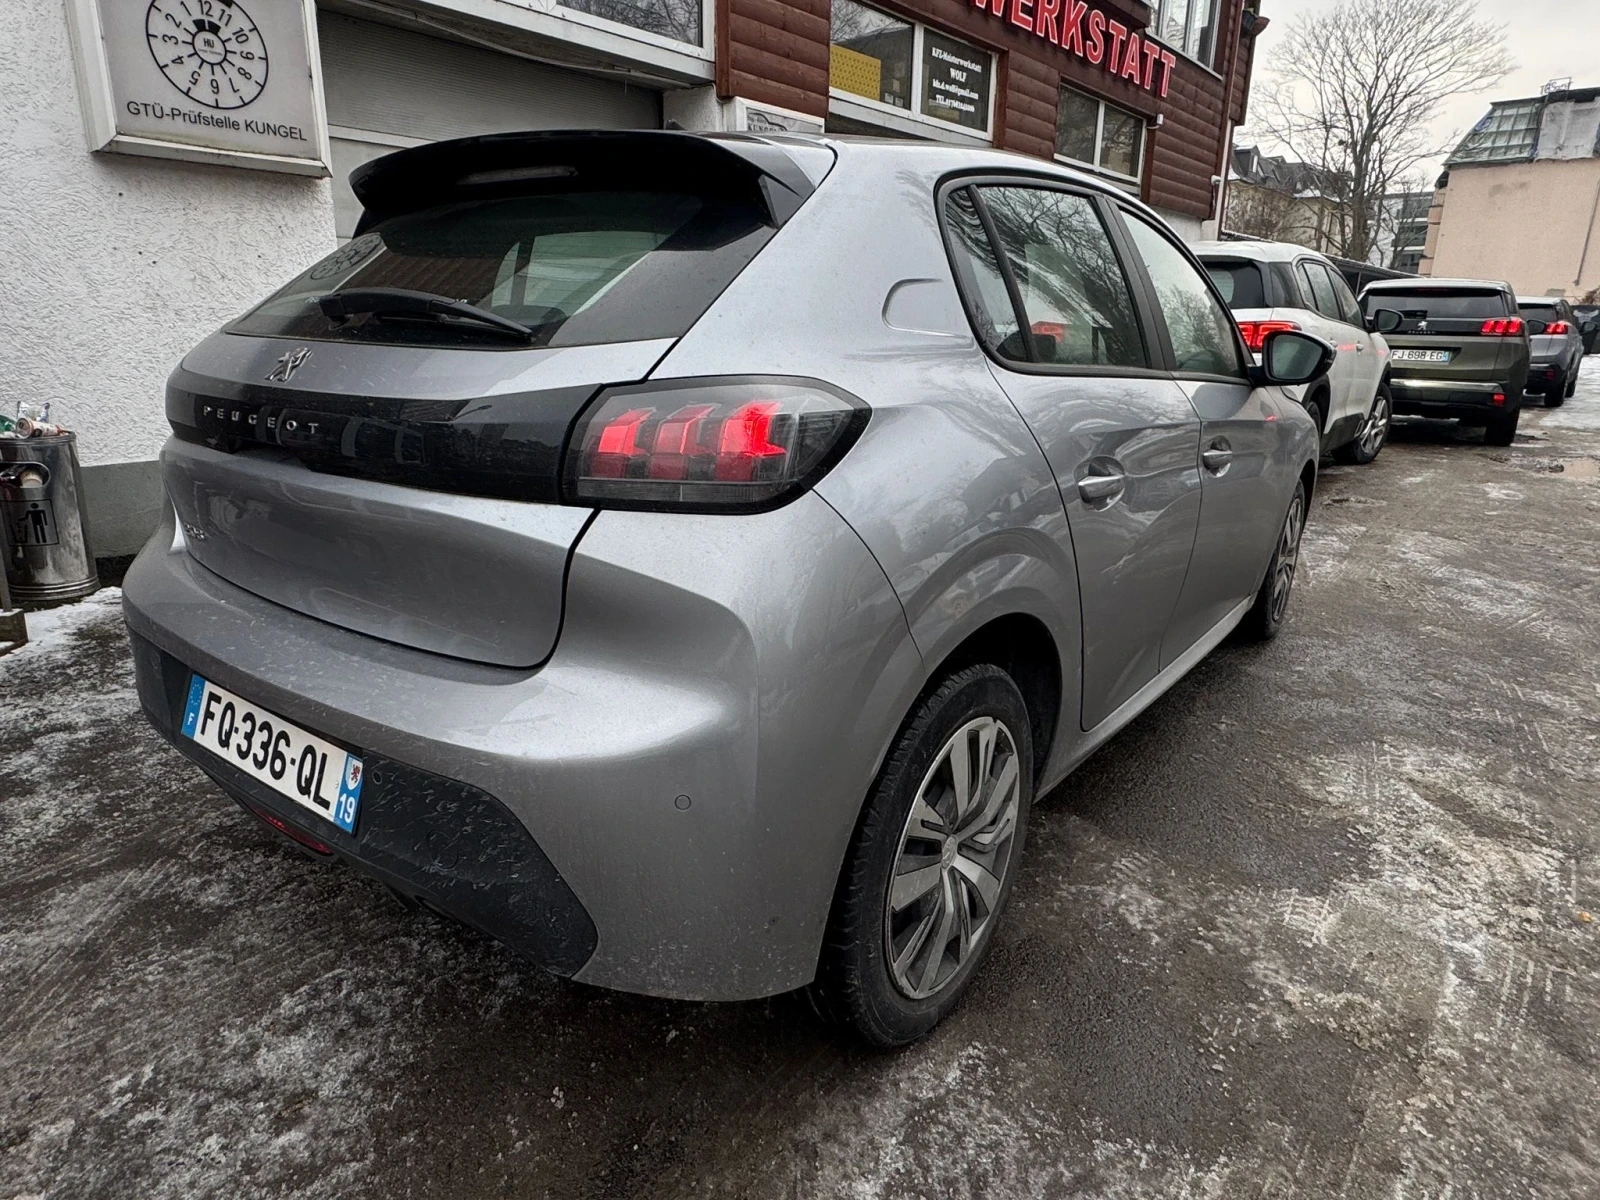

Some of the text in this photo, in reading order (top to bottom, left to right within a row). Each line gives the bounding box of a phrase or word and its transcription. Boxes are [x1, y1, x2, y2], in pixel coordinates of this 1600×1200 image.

[180, 1, 192, 16] 1
[165, 13, 182, 28] 2
[218, 8, 232, 26] 11
[162, 34, 179, 45] 3
[203, 38, 215, 48] HU
[232, 27, 249, 44] 10
[974, 0, 1177, 98] ERKSTATT
[171, 55, 184, 65] 4
[189, 70, 201, 85] 5
[237, 67, 252, 80] 8
[949, 67, 967, 83] WOLF
[229, 77, 240, 93] 7
[126, 100, 308, 141] GTÜ-Prüfstelle KUNGEL
[203, 405, 319, 434] PEUGEOT
[187, 690, 355, 823] F FQ-336-QL 19
